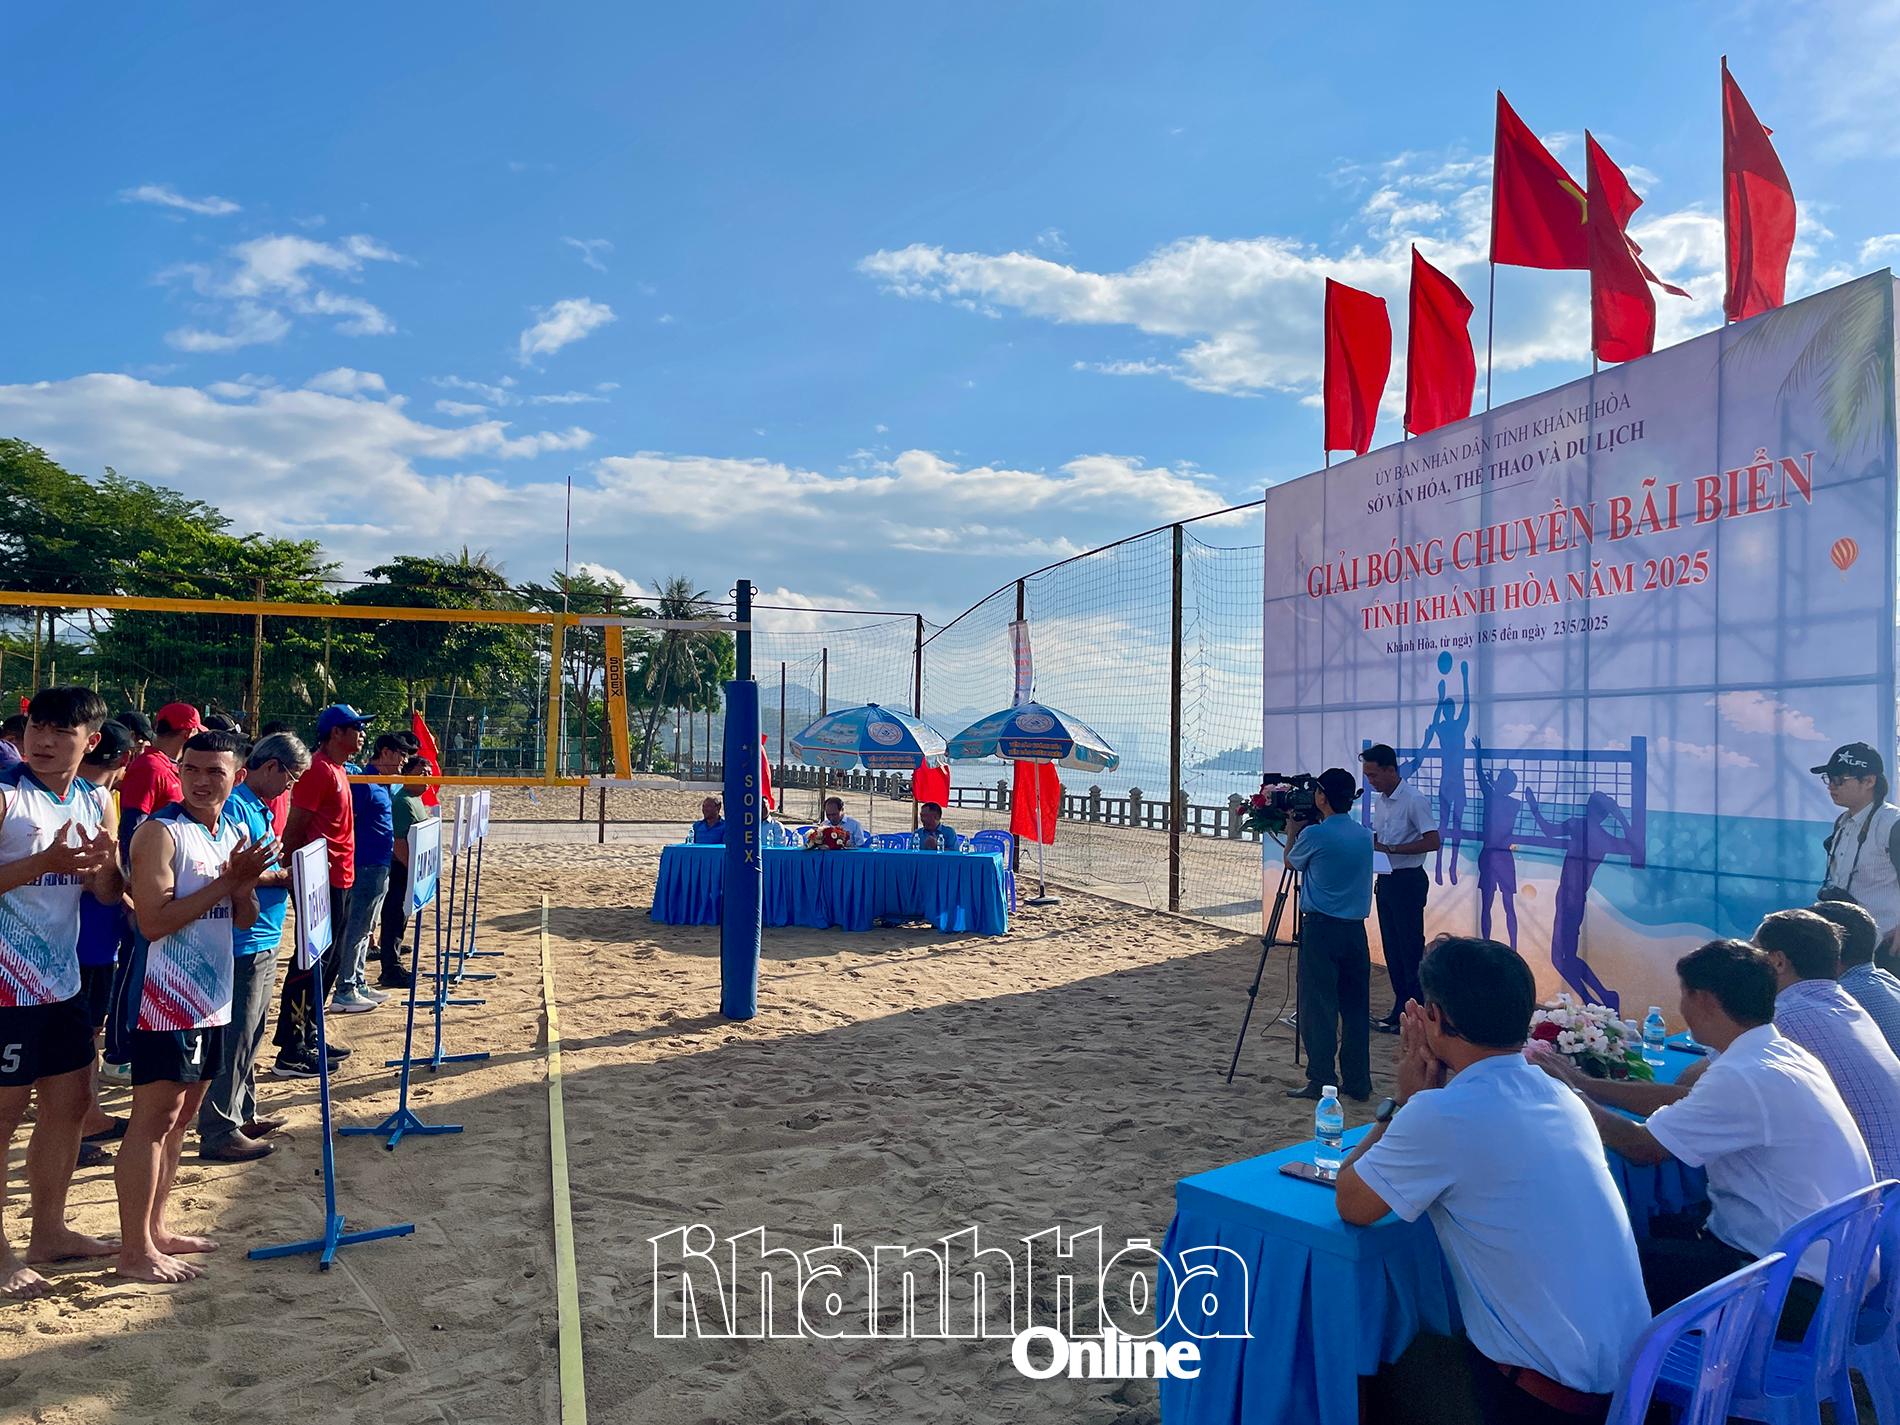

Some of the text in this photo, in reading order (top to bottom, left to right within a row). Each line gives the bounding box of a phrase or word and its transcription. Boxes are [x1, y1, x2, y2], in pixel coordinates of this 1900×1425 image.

[1367, 494, 1384, 514] SỞ
[1386, 483, 1414, 508] VĂN
[1417, 477, 1451, 500] HÓA,
[1488, 455, 1534, 481] THAO
[1538, 440, 1561, 465] VÀ
[1567, 434, 1591, 459] DU
[1596, 420, 1645, 452] LỊCH
[1394, 460, 1419, 481] BAN
[1421, 449, 1458, 473] NHÂN
[1462, 436, 1490, 460] DÂN
[1532, 407, 1589, 437] KHÁNH
[1594, 392, 1631, 418] HÒA
[1307, 447, 1817, 599] GIẢI BÓNG CHUYỀN BÃI BIỂN
[1361, 550, 1711, 631] TỈNH KHÁNH HÒA NĂM 2025
[1386, 614, 1609, 654] Khánh Hòa, từ ngày 18/5 đến ngày 23/5/2025
[609, 656, 620, 697] SODEX
[1848, 759, 1867, 768] LFC
[743, 774, 754, 863] SODEX
[1, 1043, 22, 1073] 5
